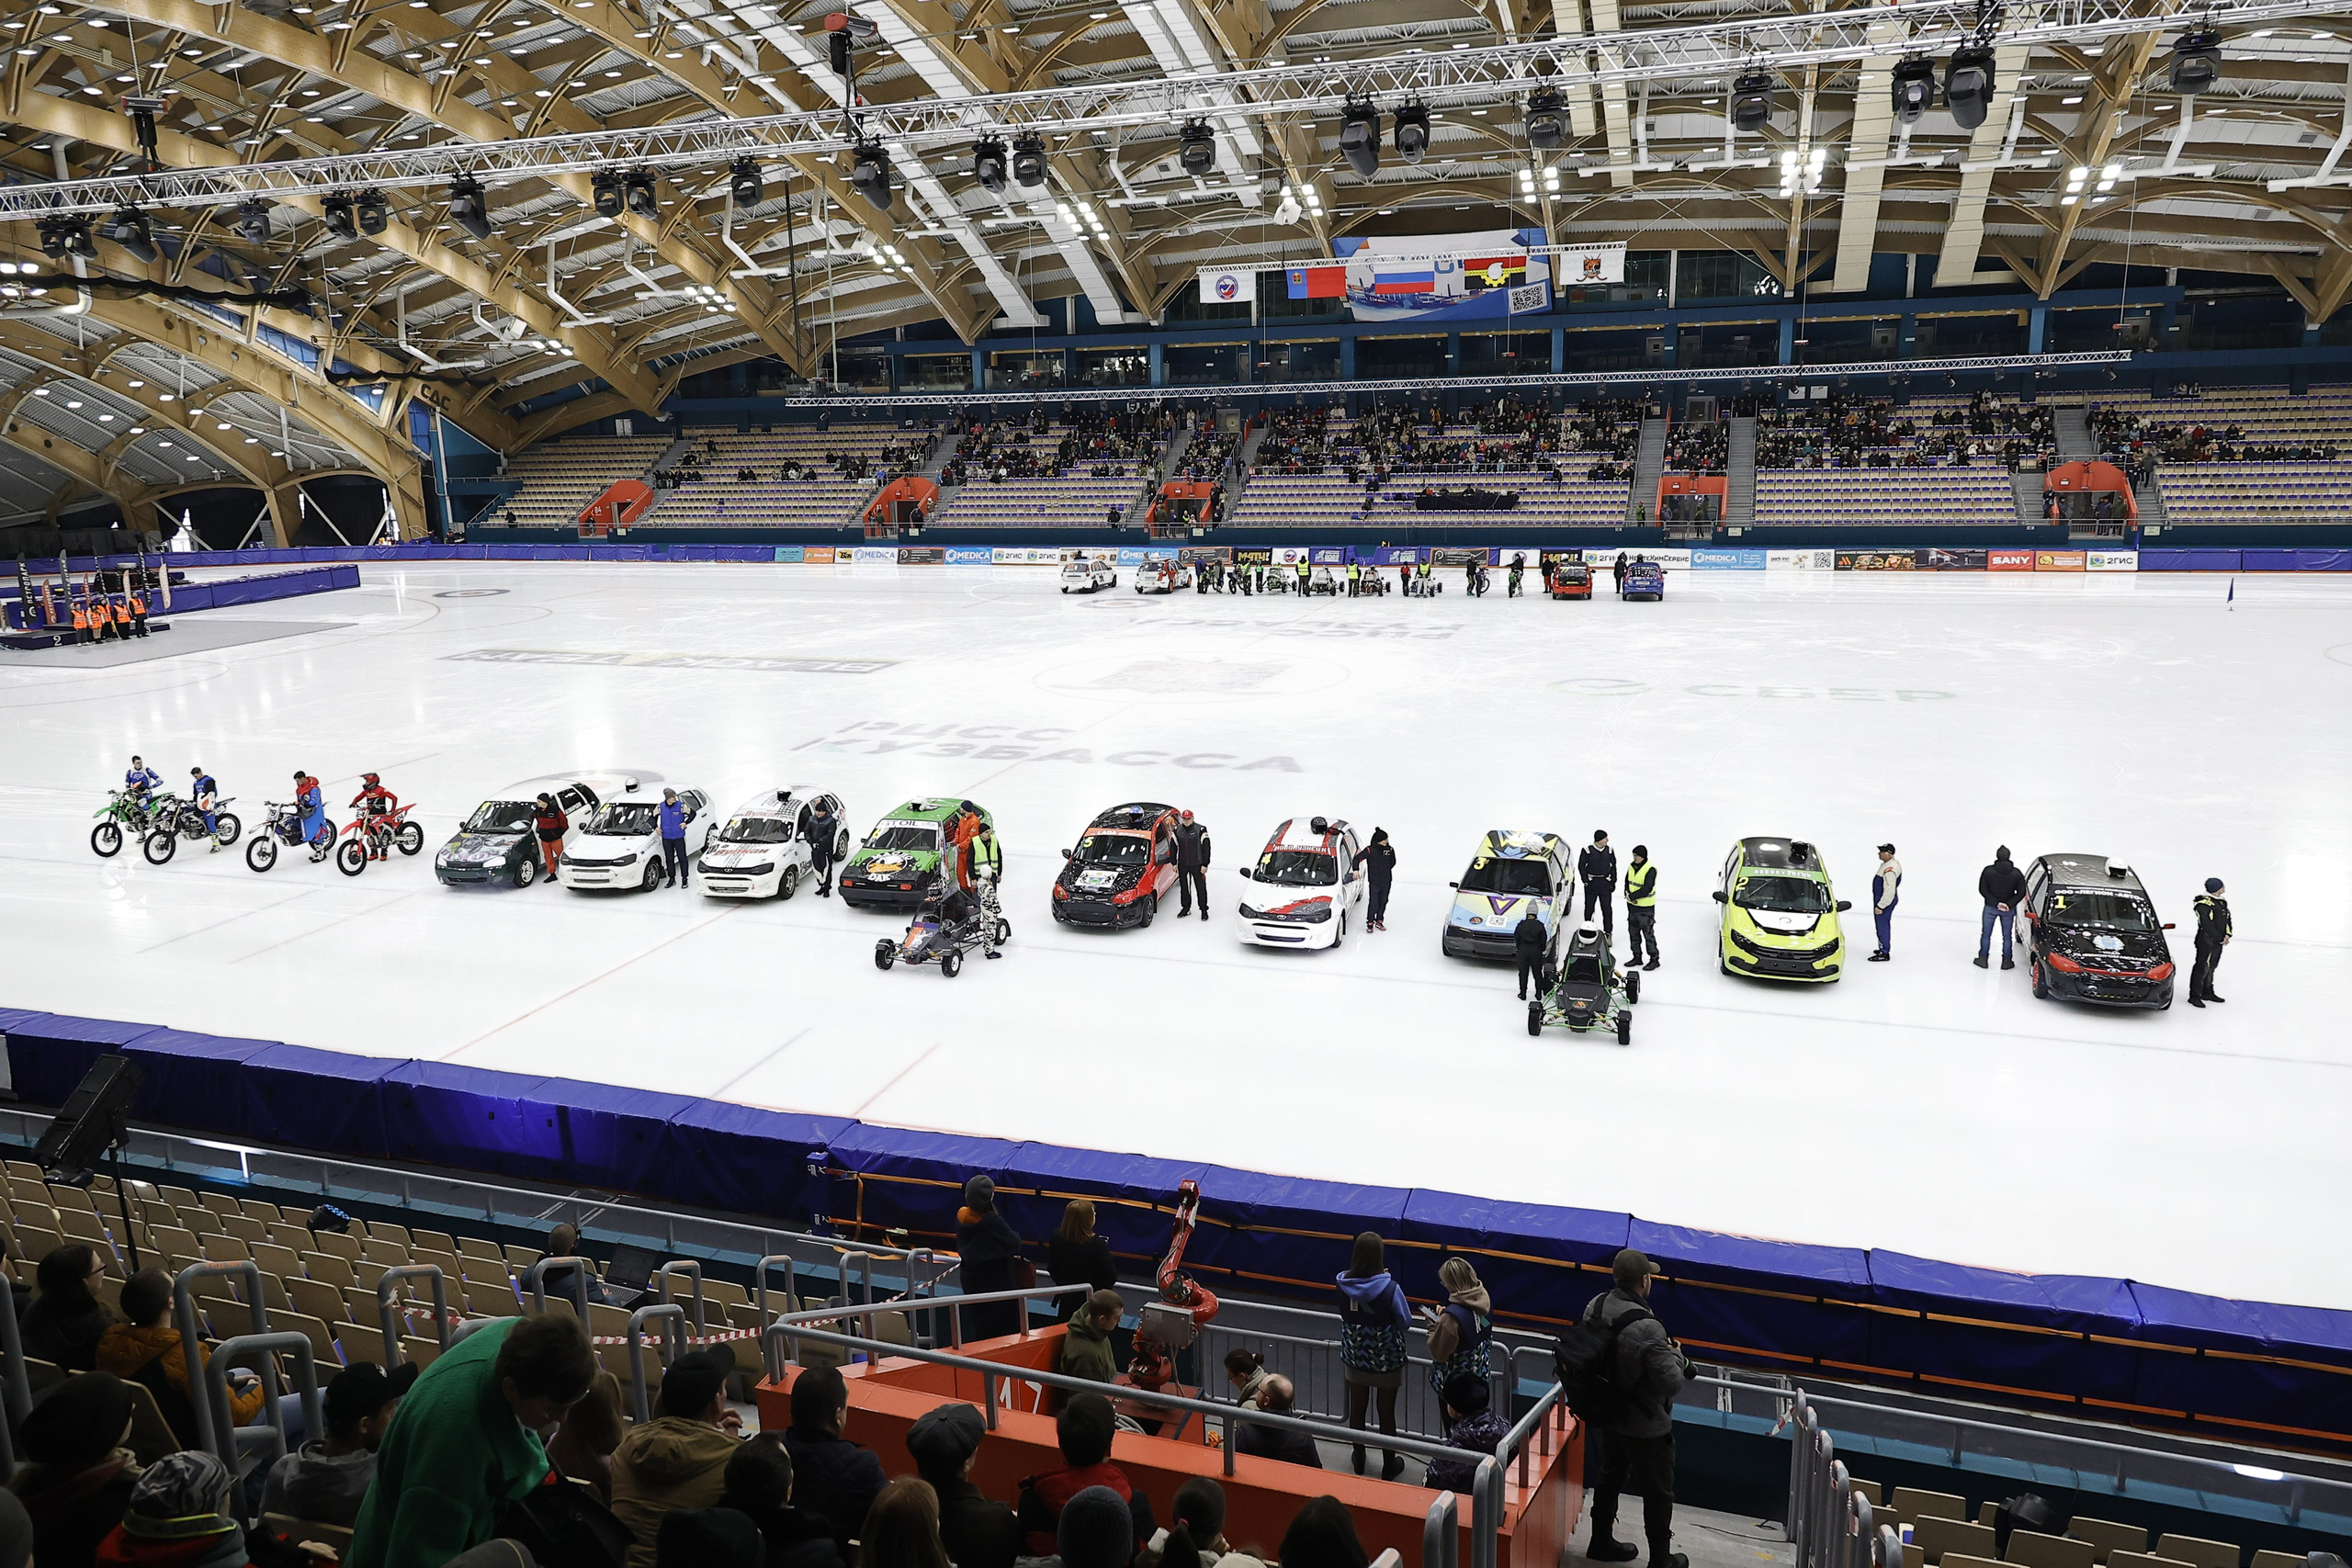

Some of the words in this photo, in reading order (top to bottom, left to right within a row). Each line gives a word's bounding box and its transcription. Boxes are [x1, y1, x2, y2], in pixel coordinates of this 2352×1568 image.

[957, 551, 990, 559] MEDICA
[1704, 554, 1736, 562] MEDICA
[1992, 556, 2031, 564] SANY
[2107, 557, 2133, 565] 2ГИС
[18, 561, 35, 604] ПЕТРОПАРК
[52, 635, 62, 647] 2
[670, 657, 888, 674] BLACK
[1684, 682, 1958, 702] СБЕР
[834, 719, 1078, 742] РЦСС
[790, 737, 1305, 773] КУЗБАССА
[744, 809, 781, 818] Вулкан
[1083, 837, 1094, 848] 5
[713, 847, 770, 856] Вулкан
[1473, 857, 1485, 870] 3
[867, 873, 891, 882] DAK
[1754, 869, 1813, 878] НОВОКУЗНЕЦК
[1735, 877, 1749, 891] 2
[2054, 896, 2067, 908] 1
